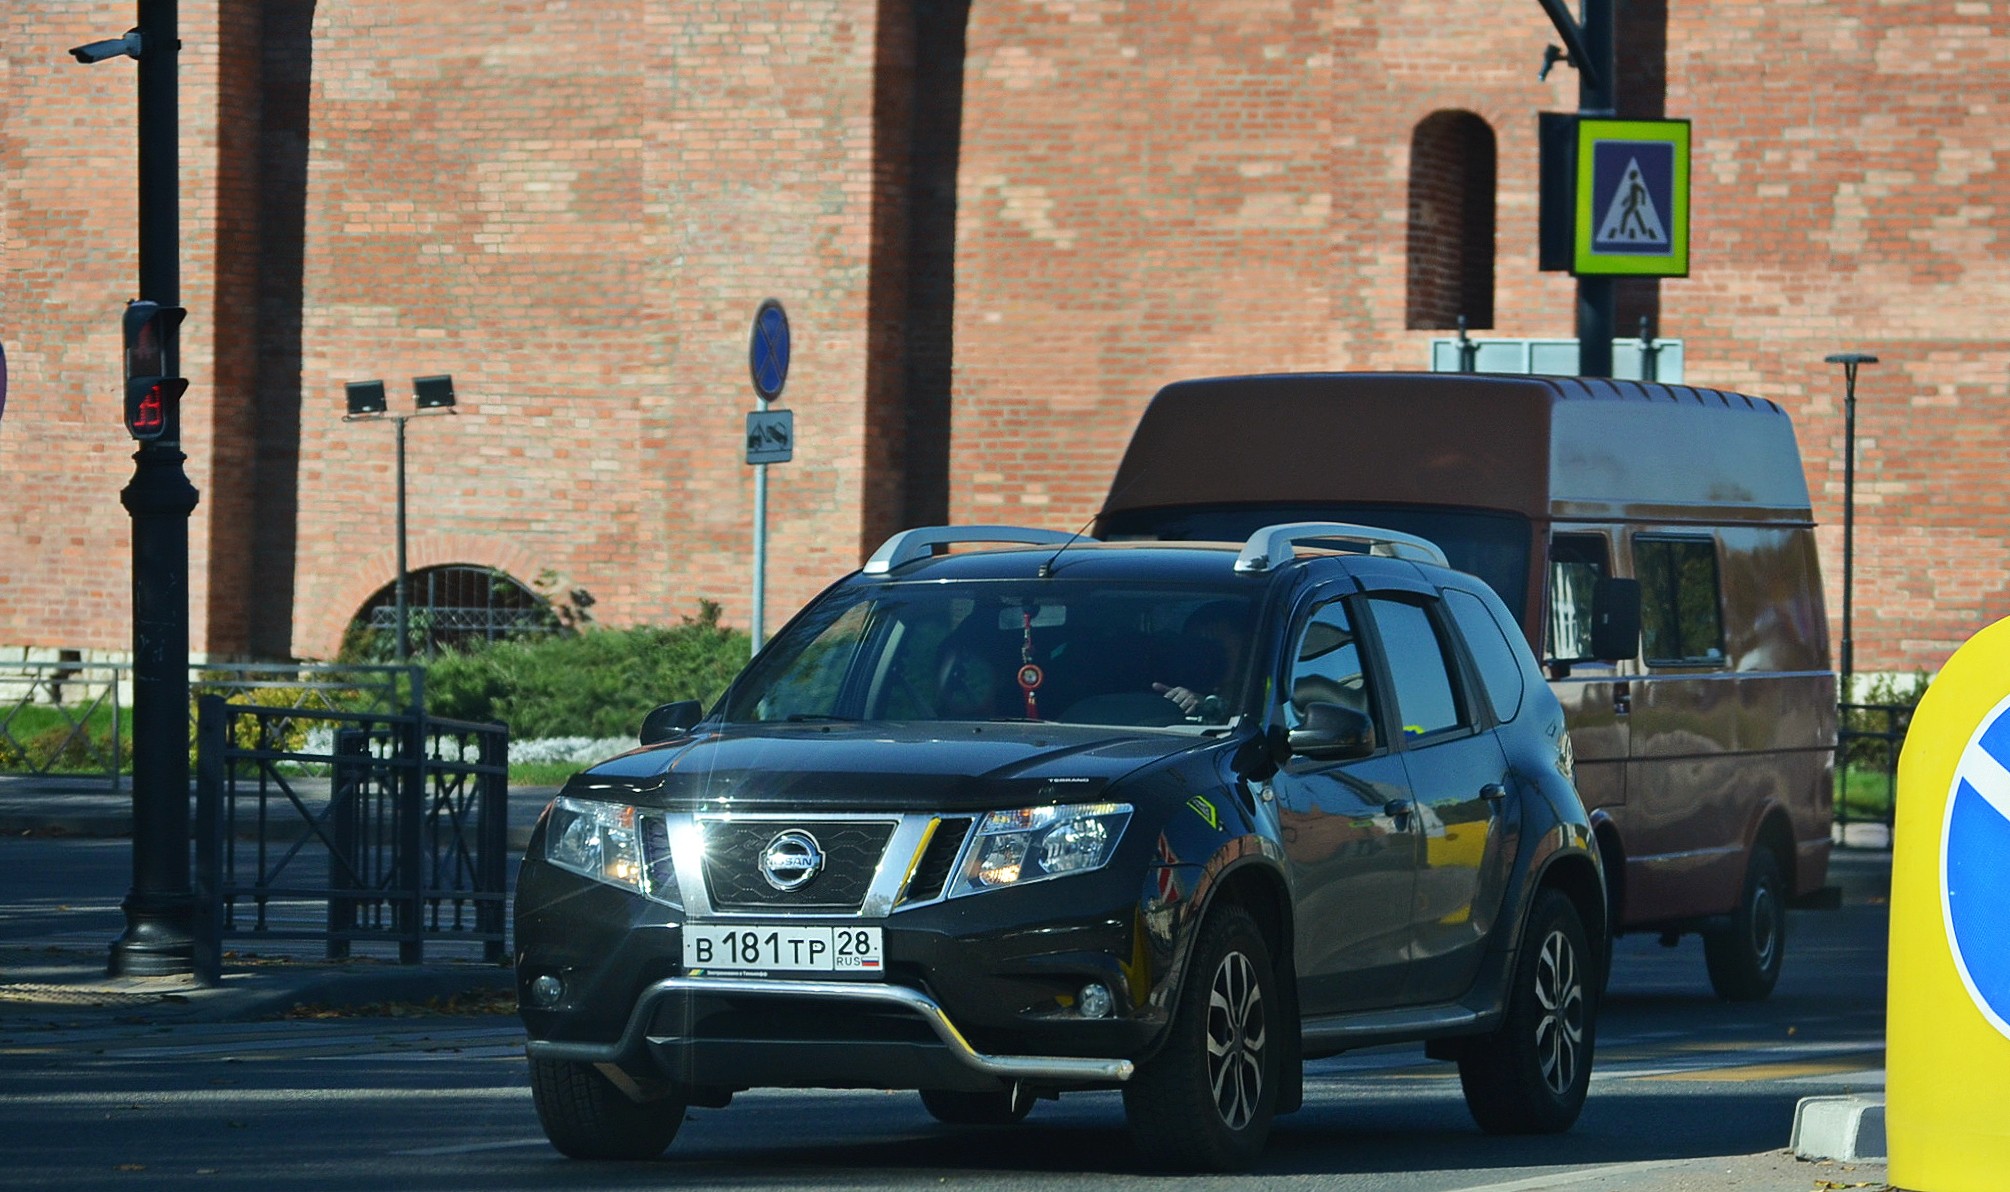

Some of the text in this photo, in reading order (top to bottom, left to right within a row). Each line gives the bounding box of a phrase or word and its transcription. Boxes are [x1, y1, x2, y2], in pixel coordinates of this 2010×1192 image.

[765, 857, 812, 866] NSAN
[837, 930, 871, 956] 28
[836, 956, 861, 967] RUS
